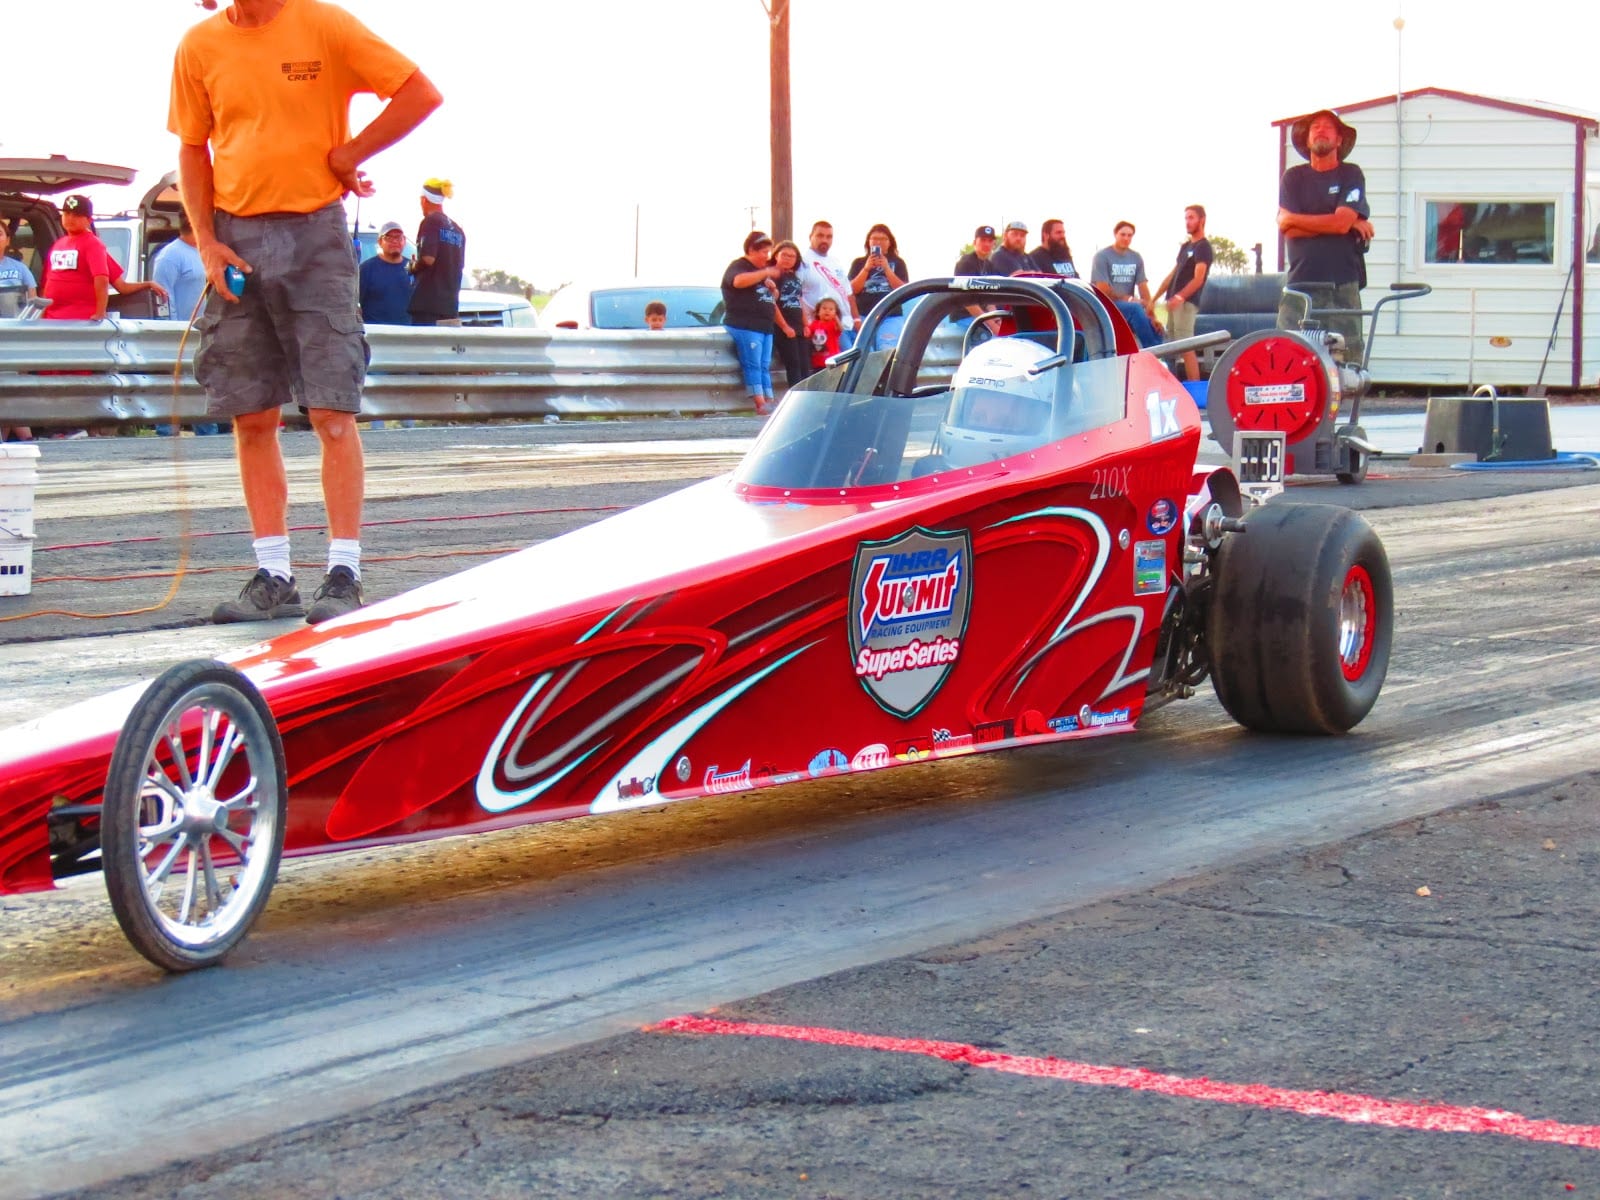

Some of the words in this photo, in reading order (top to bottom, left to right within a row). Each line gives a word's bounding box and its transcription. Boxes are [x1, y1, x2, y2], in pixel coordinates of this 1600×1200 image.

[968, 376, 1005, 388] zamp
[1089, 465, 1132, 500] 210X
[890, 548, 947, 573] IHRA
[871, 625, 902, 639] RACING
[905, 617, 951, 635] EQUIPMENT
[856, 637, 958, 678] SuperSeries
